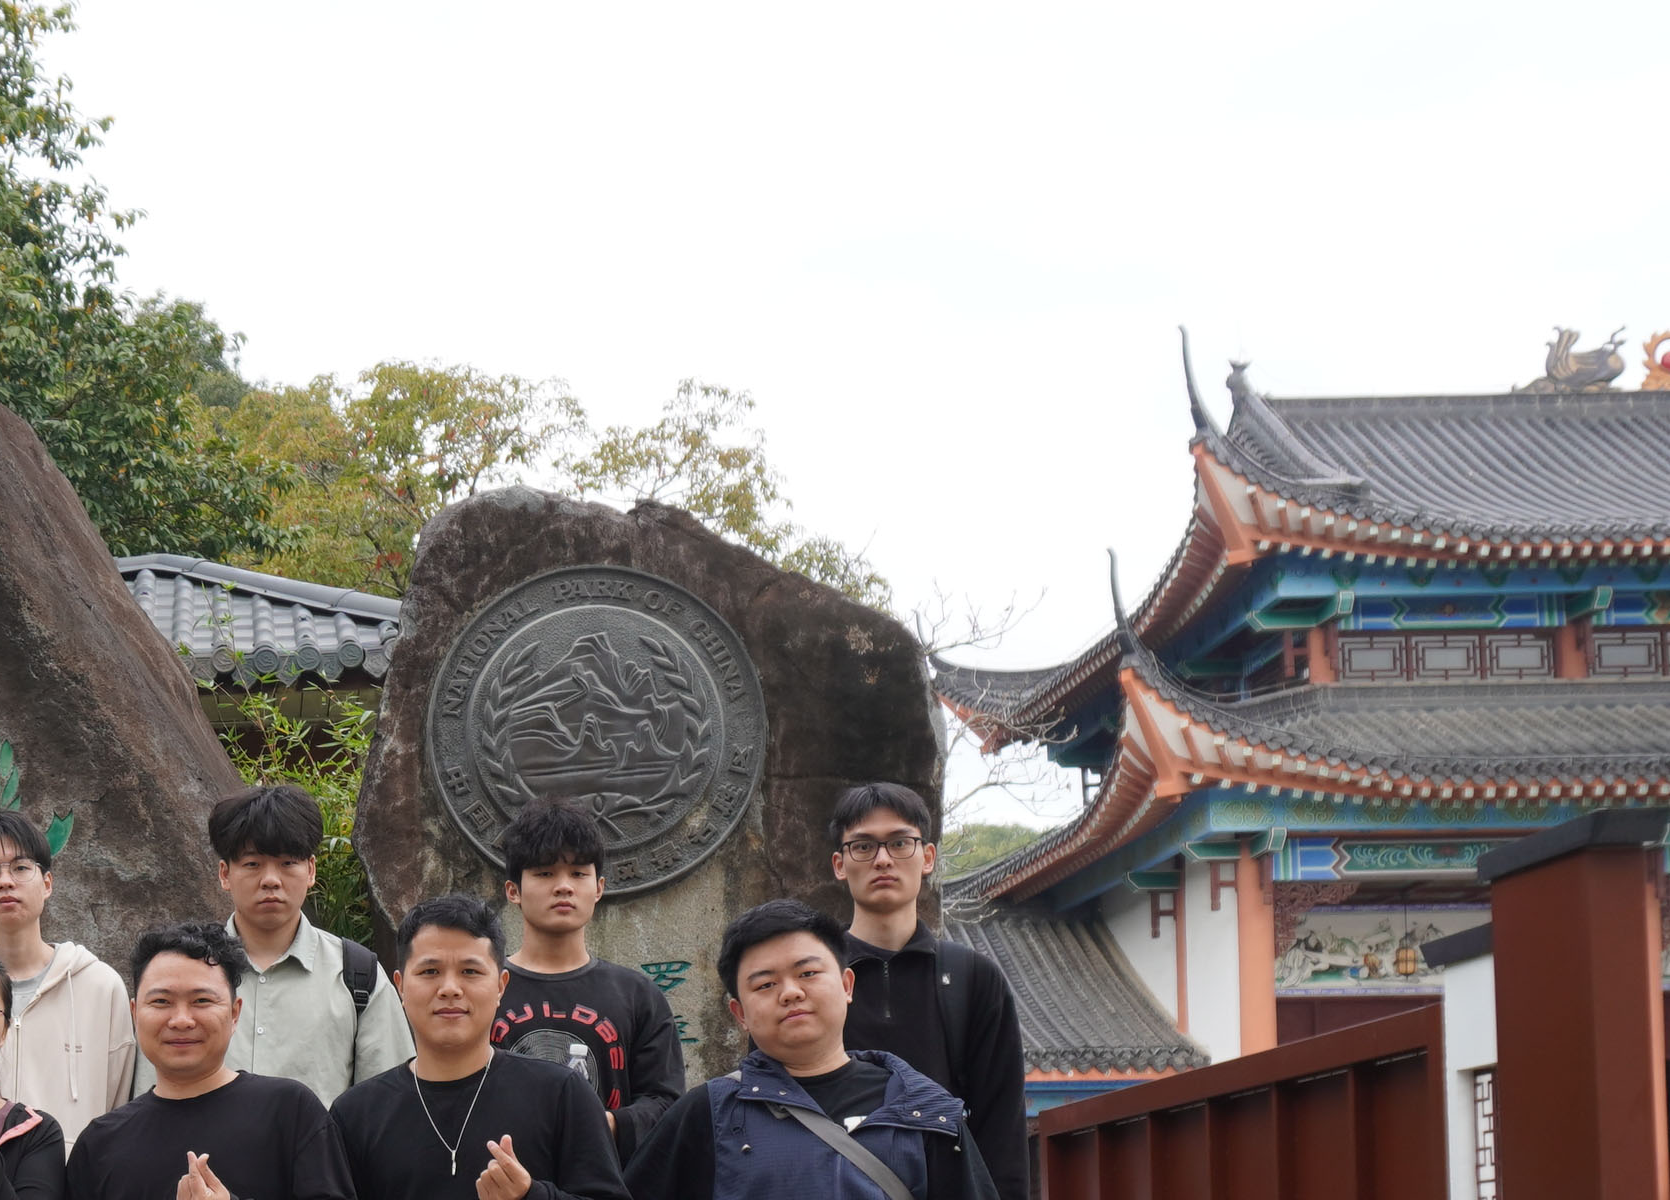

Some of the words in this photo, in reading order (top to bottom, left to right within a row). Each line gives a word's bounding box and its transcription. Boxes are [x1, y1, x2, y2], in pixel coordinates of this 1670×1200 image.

[442, 600, 541, 718] NATIONAL
[551, 578, 634, 602] PARK
[643, 590, 685, 618] OF
[688, 619, 747, 702] CHINA
